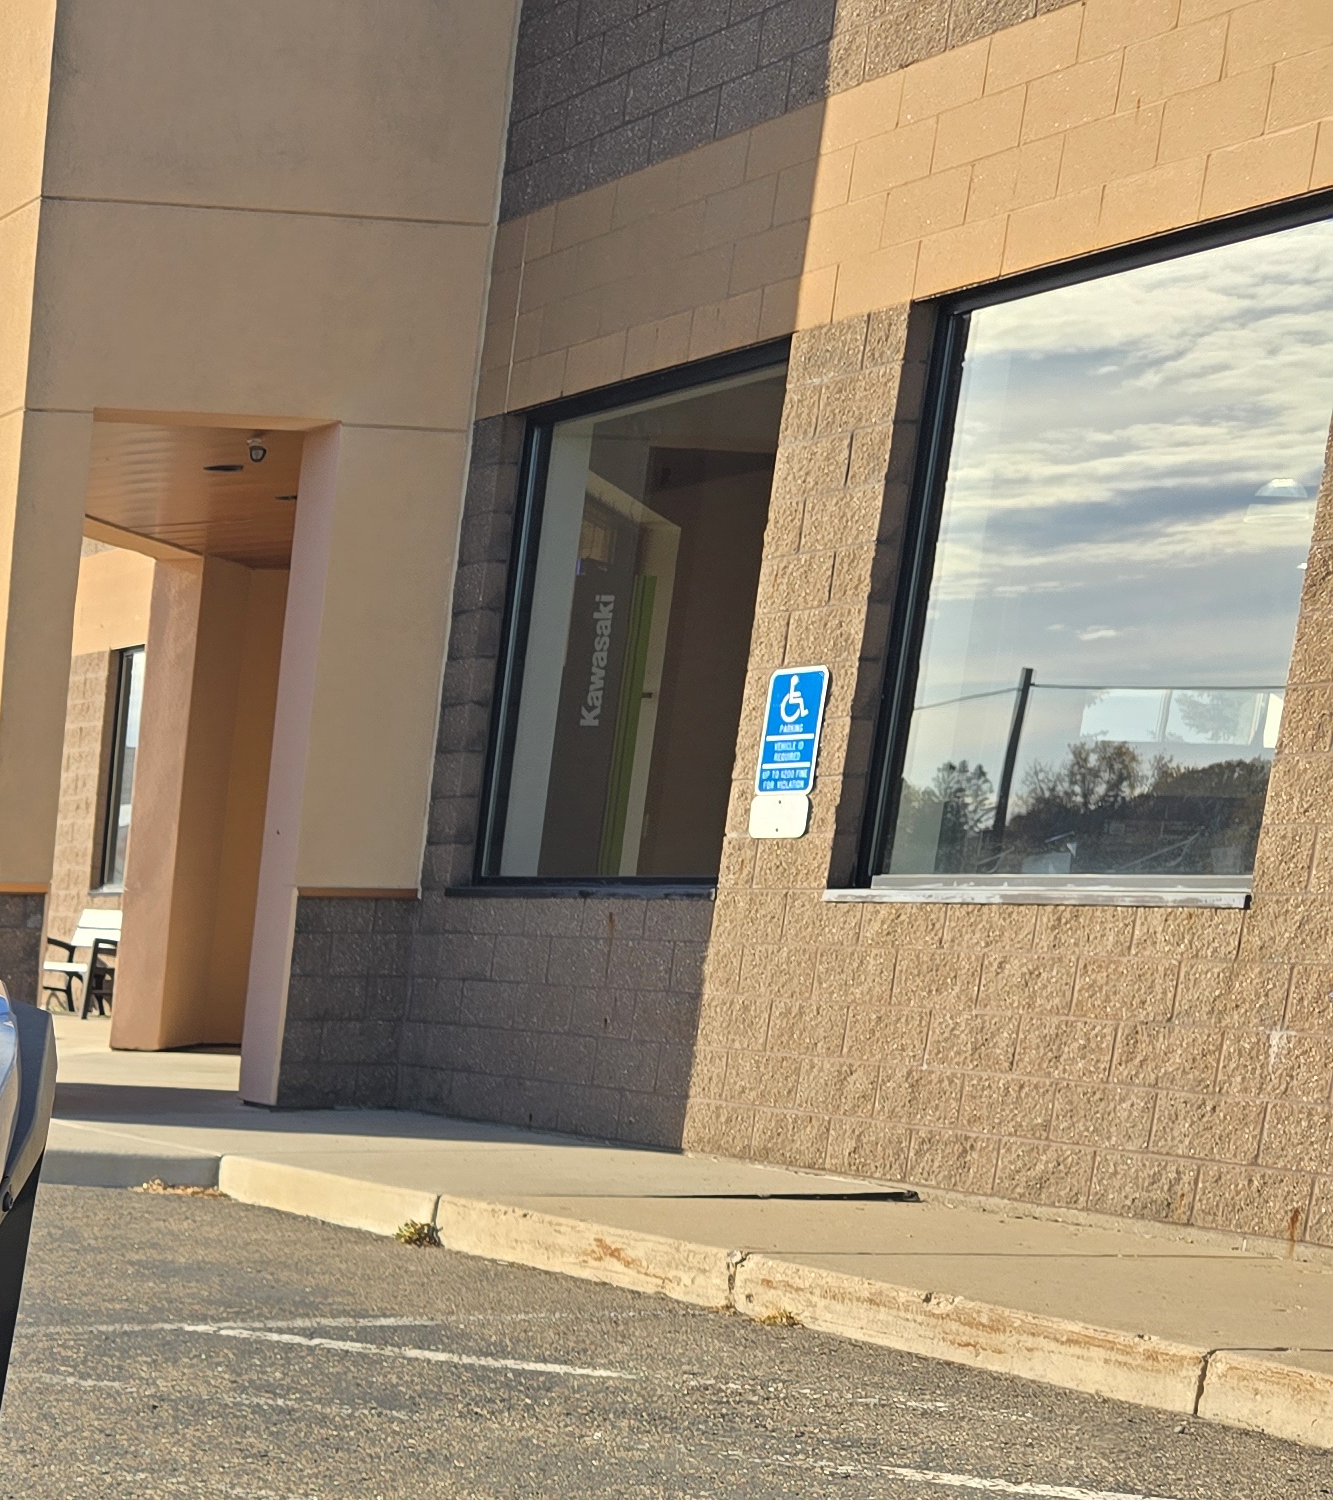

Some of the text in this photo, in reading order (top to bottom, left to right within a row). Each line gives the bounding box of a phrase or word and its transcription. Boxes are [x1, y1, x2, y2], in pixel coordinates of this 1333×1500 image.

[580, 594, 615, 726] Kawasaki
[779, 723, 804, 733] PARKING
[774, 741, 796, 751] VEHICLE
[762, 770, 771, 780] UP
[771, 769, 780, 779] TO
[762, 780, 775, 789] FOR
